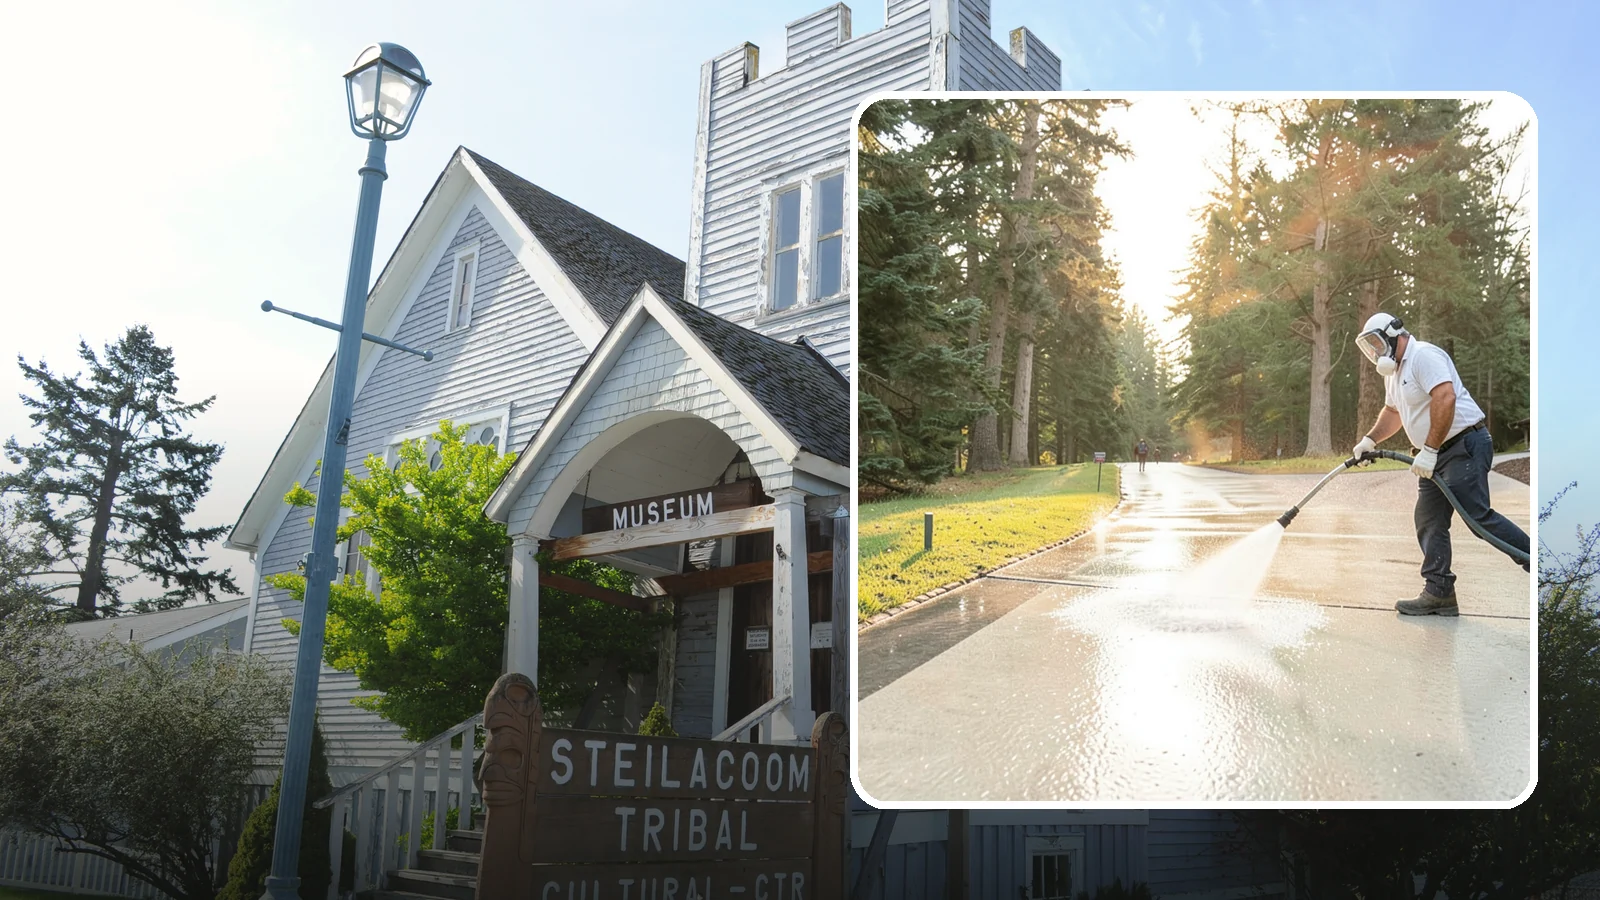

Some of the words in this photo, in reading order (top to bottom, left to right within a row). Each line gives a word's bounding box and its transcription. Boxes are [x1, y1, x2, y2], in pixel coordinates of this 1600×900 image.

[613, 491, 713, 530] MUSEUM
[551, 738, 809, 792] STEILACOOM
[615, 806, 757, 851] TRIBAL
